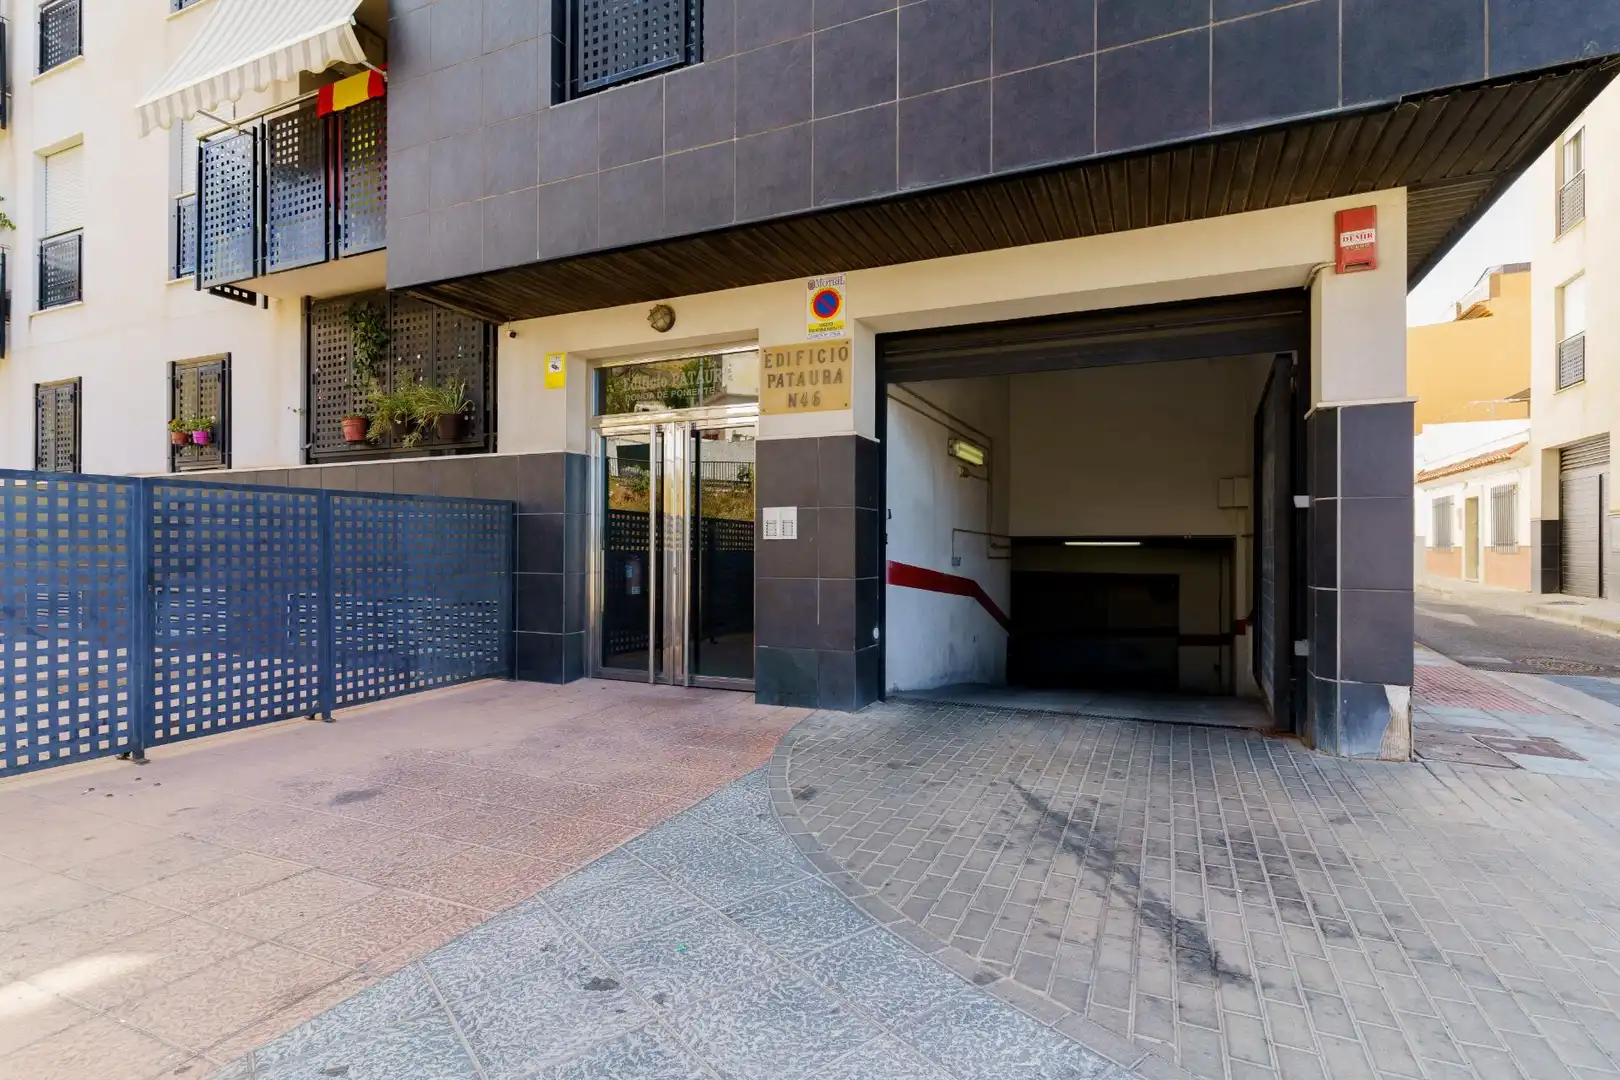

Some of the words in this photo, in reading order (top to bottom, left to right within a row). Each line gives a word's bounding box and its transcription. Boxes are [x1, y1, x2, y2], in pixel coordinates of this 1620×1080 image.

[764, 346, 849, 369] EDIFICIO
[767, 368, 844, 389] PATAURA
[625, 392, 655, 403] RONDA
[656, 390, 669, 400] DE
